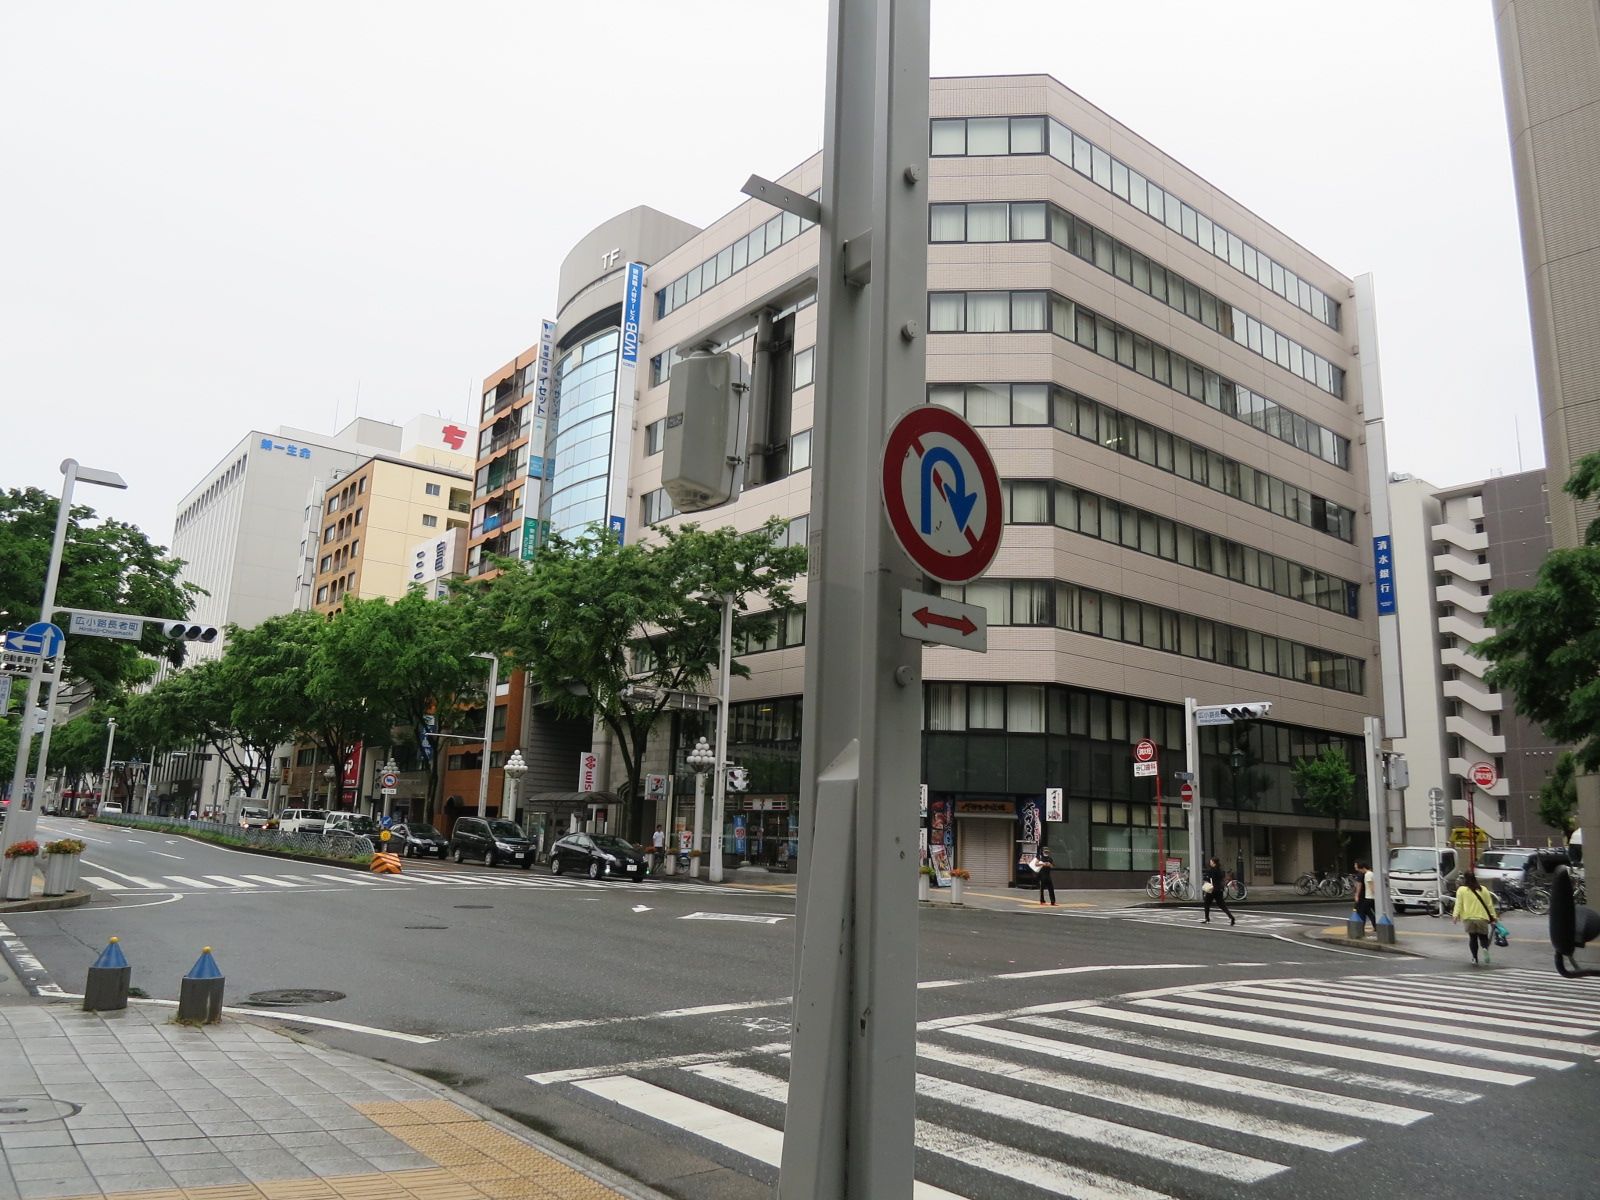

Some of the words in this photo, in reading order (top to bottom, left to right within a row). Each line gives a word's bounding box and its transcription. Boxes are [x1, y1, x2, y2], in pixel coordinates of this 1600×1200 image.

[601, 248, 620, 270] TF
[623, 321, 638, 356] WDB
[260, 438, 311, 459] 第一生命
[1377, 540, 1390, 593] 清水銀行
